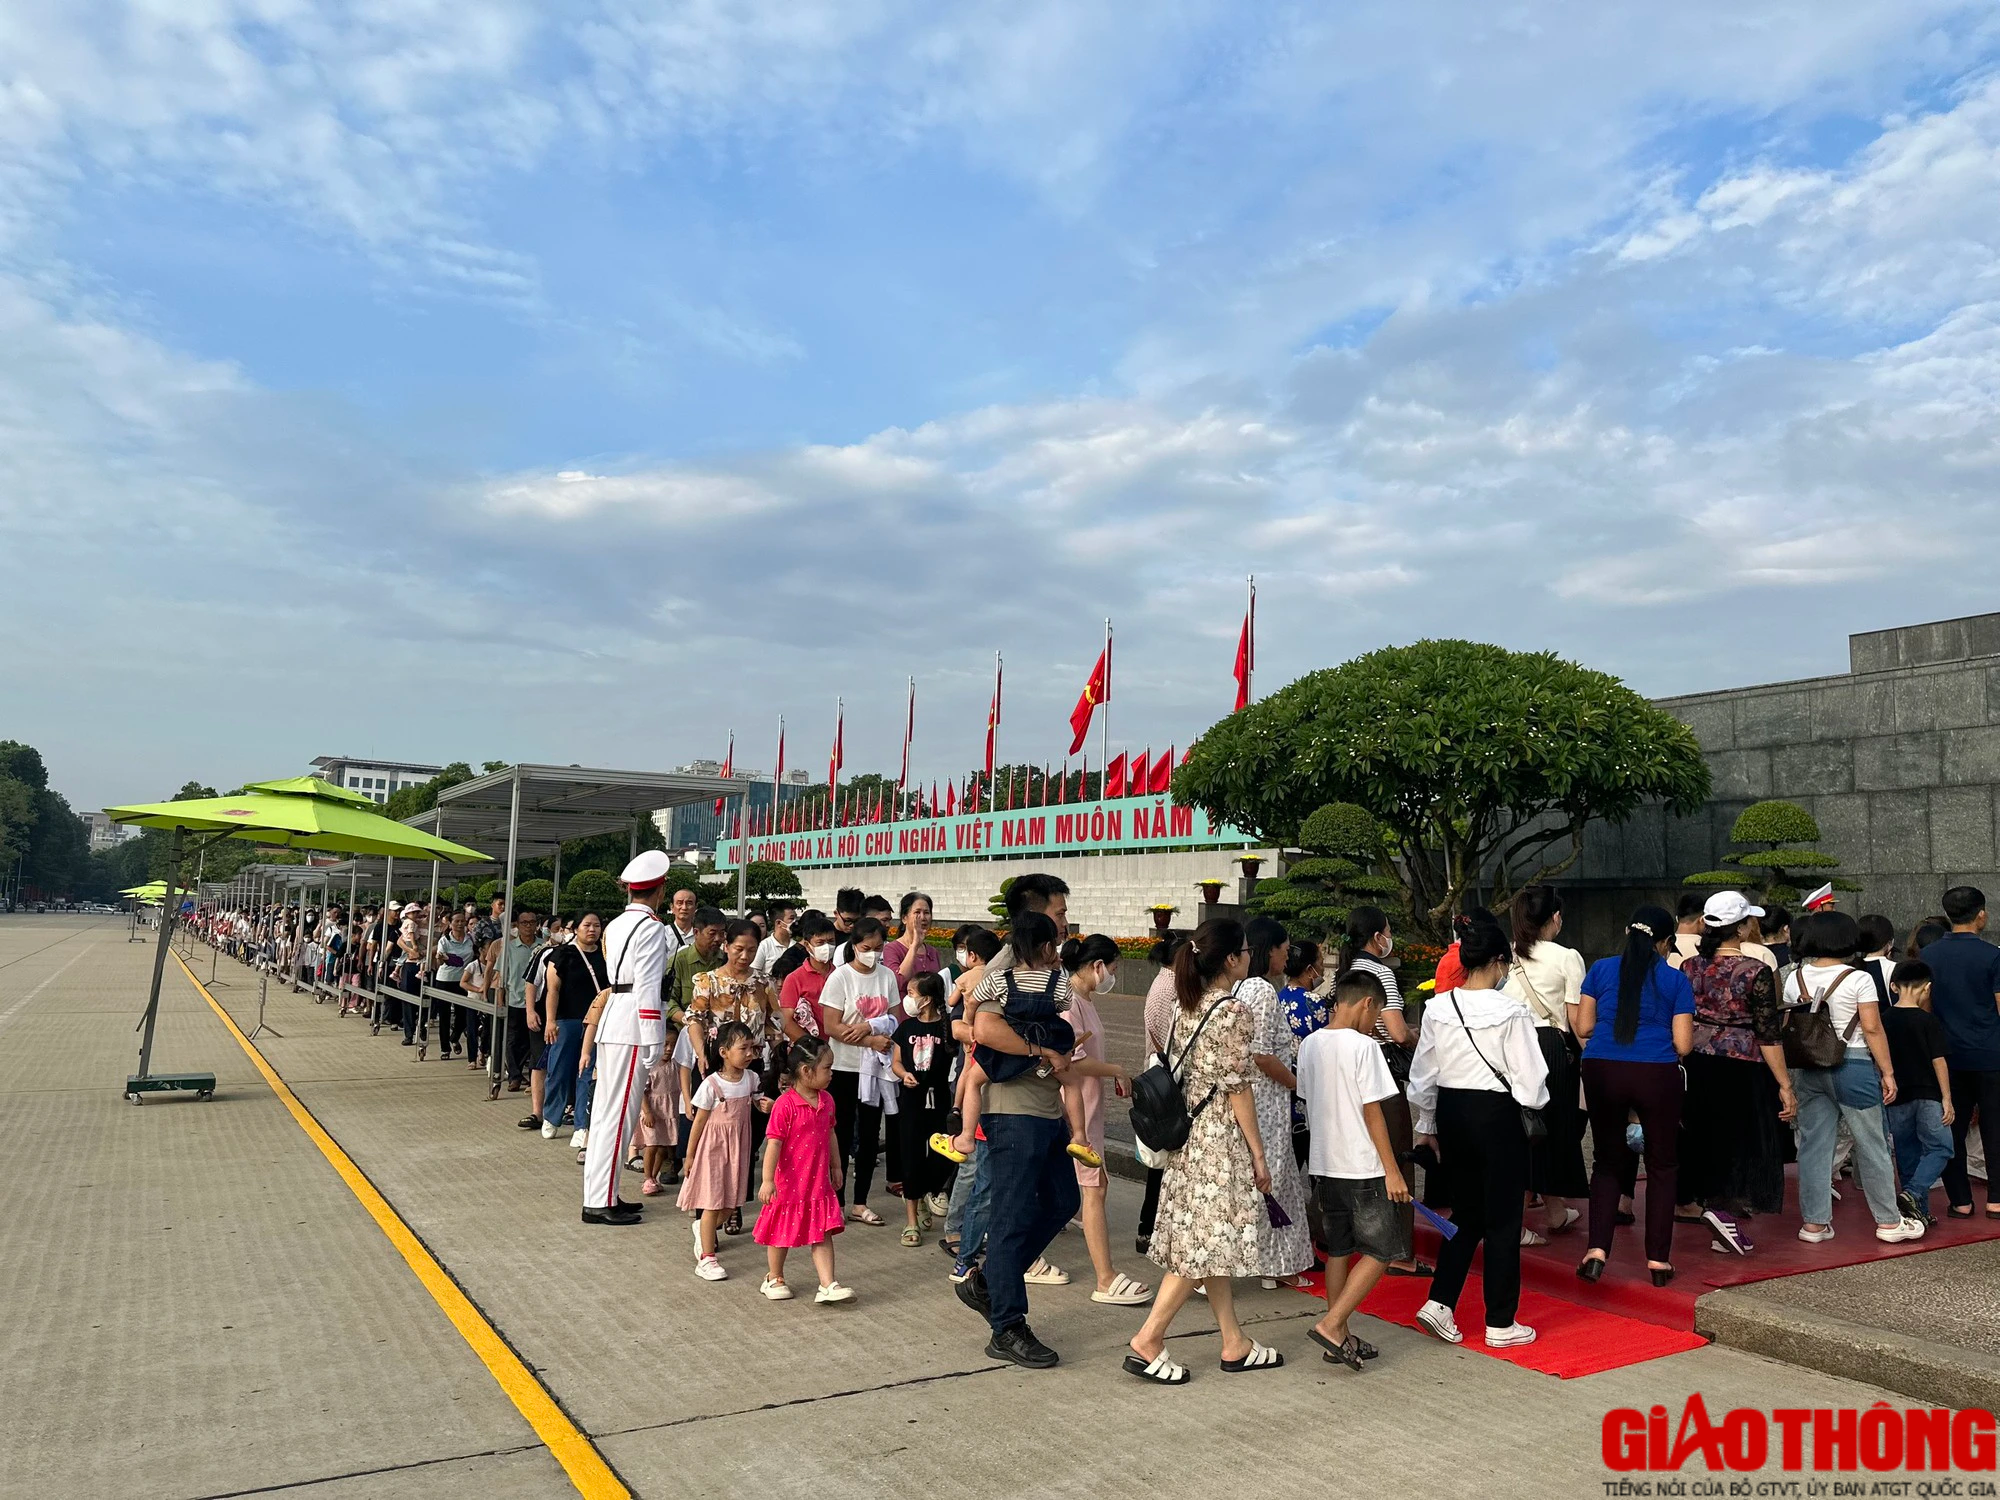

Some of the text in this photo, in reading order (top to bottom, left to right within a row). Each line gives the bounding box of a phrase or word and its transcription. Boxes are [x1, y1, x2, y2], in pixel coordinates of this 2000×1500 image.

[790, 835, 812, 860] HÒA
[817, 832, 833, 859] XÃ
[838, 830, 860, 861] HỘI
[865, 825, 893, 855] CHỦ
[899, 822, 946, 853] NGHĨA
[955, 817, 993, 854] VIỆT
[1002, 816, 1046, 847] NAM
[1055, 806, 1122, 844] MUÔN
[1133, 800, 1193, 839] NĂM
